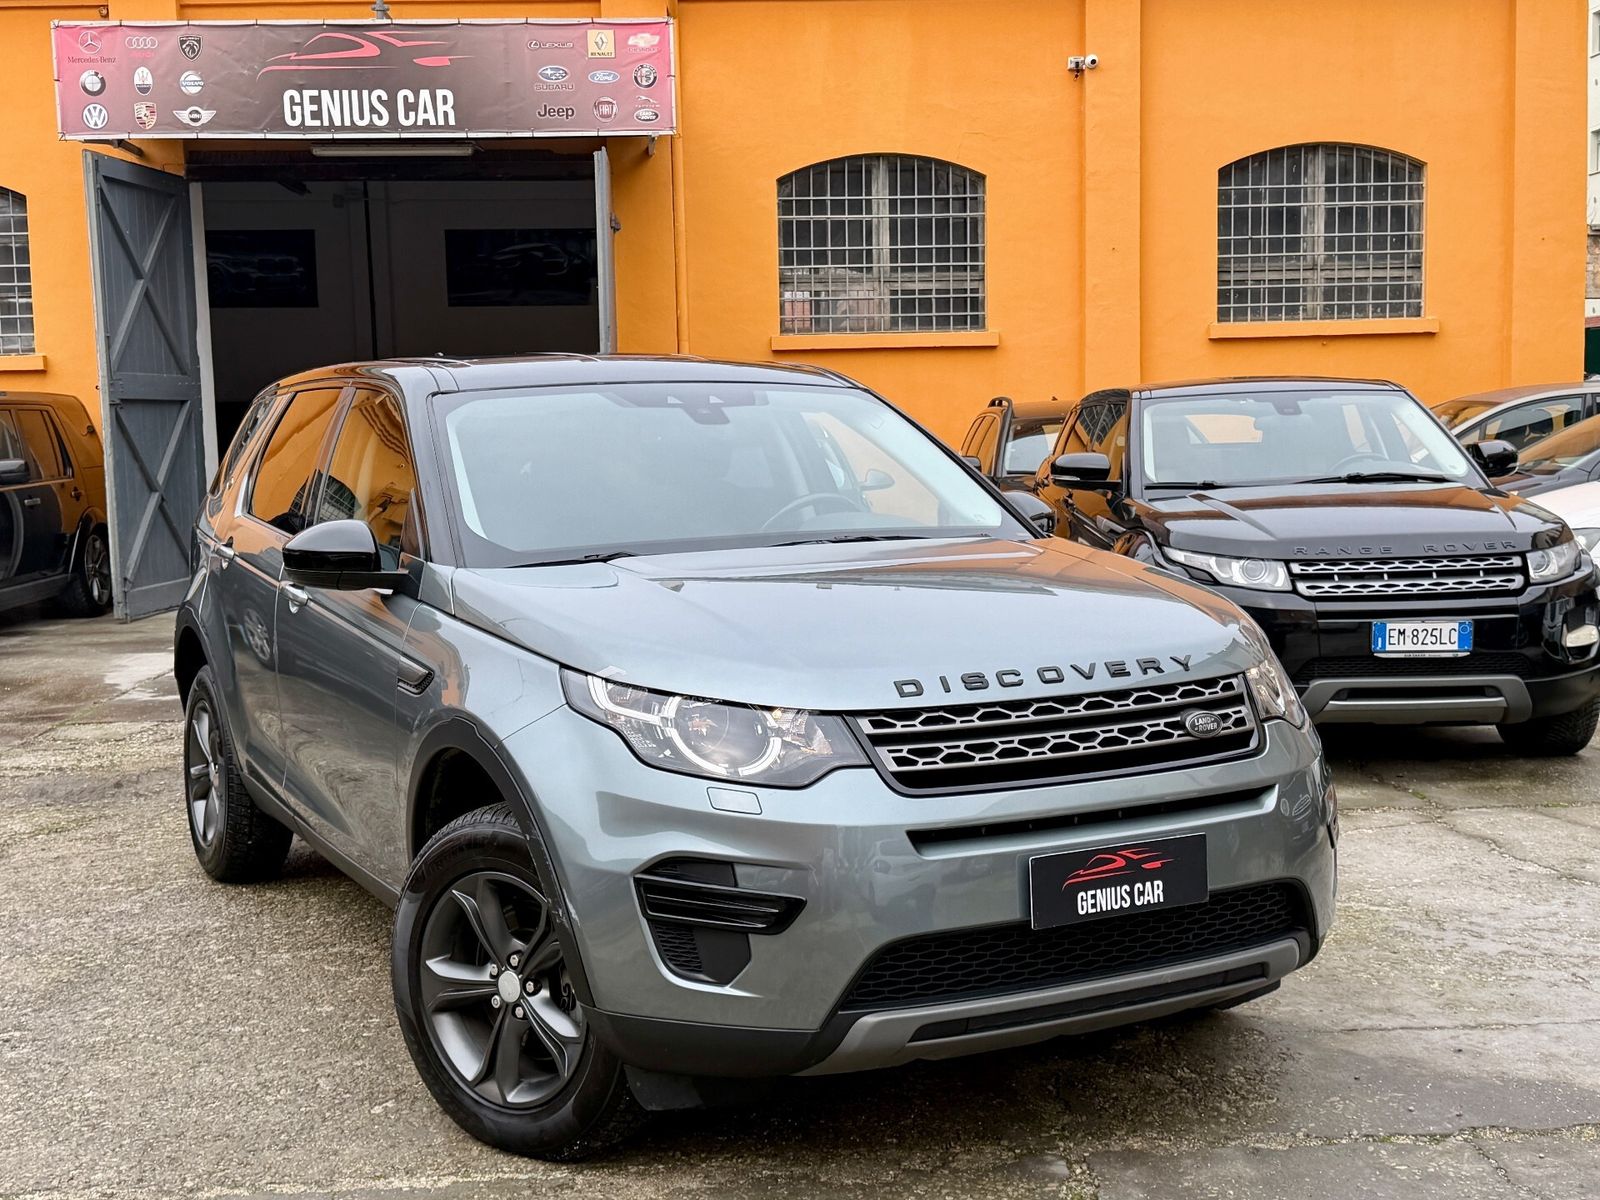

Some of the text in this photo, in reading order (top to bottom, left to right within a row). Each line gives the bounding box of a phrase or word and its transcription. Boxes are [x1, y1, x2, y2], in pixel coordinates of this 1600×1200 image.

[535, 83, 574, 91] SUBARU
[283, 89, 456, 127] GENIUS CAR
[537, 104, 575, 119] Jeep
[599, 104, 613, 116] FIAT
[1293, 540, 1518, 556] RANGE ROVER
[1388, 628, 1406, 646] EM
[1411, 628, 1457, 646] 825LC
[893, 654, 1193, 698] DISCOVERY
[1194, 717, 1211, 726] LAND
[1198, 722, 1218, 731] ROVER
[1077, 880, 1164, 916] GENIUS CAR
